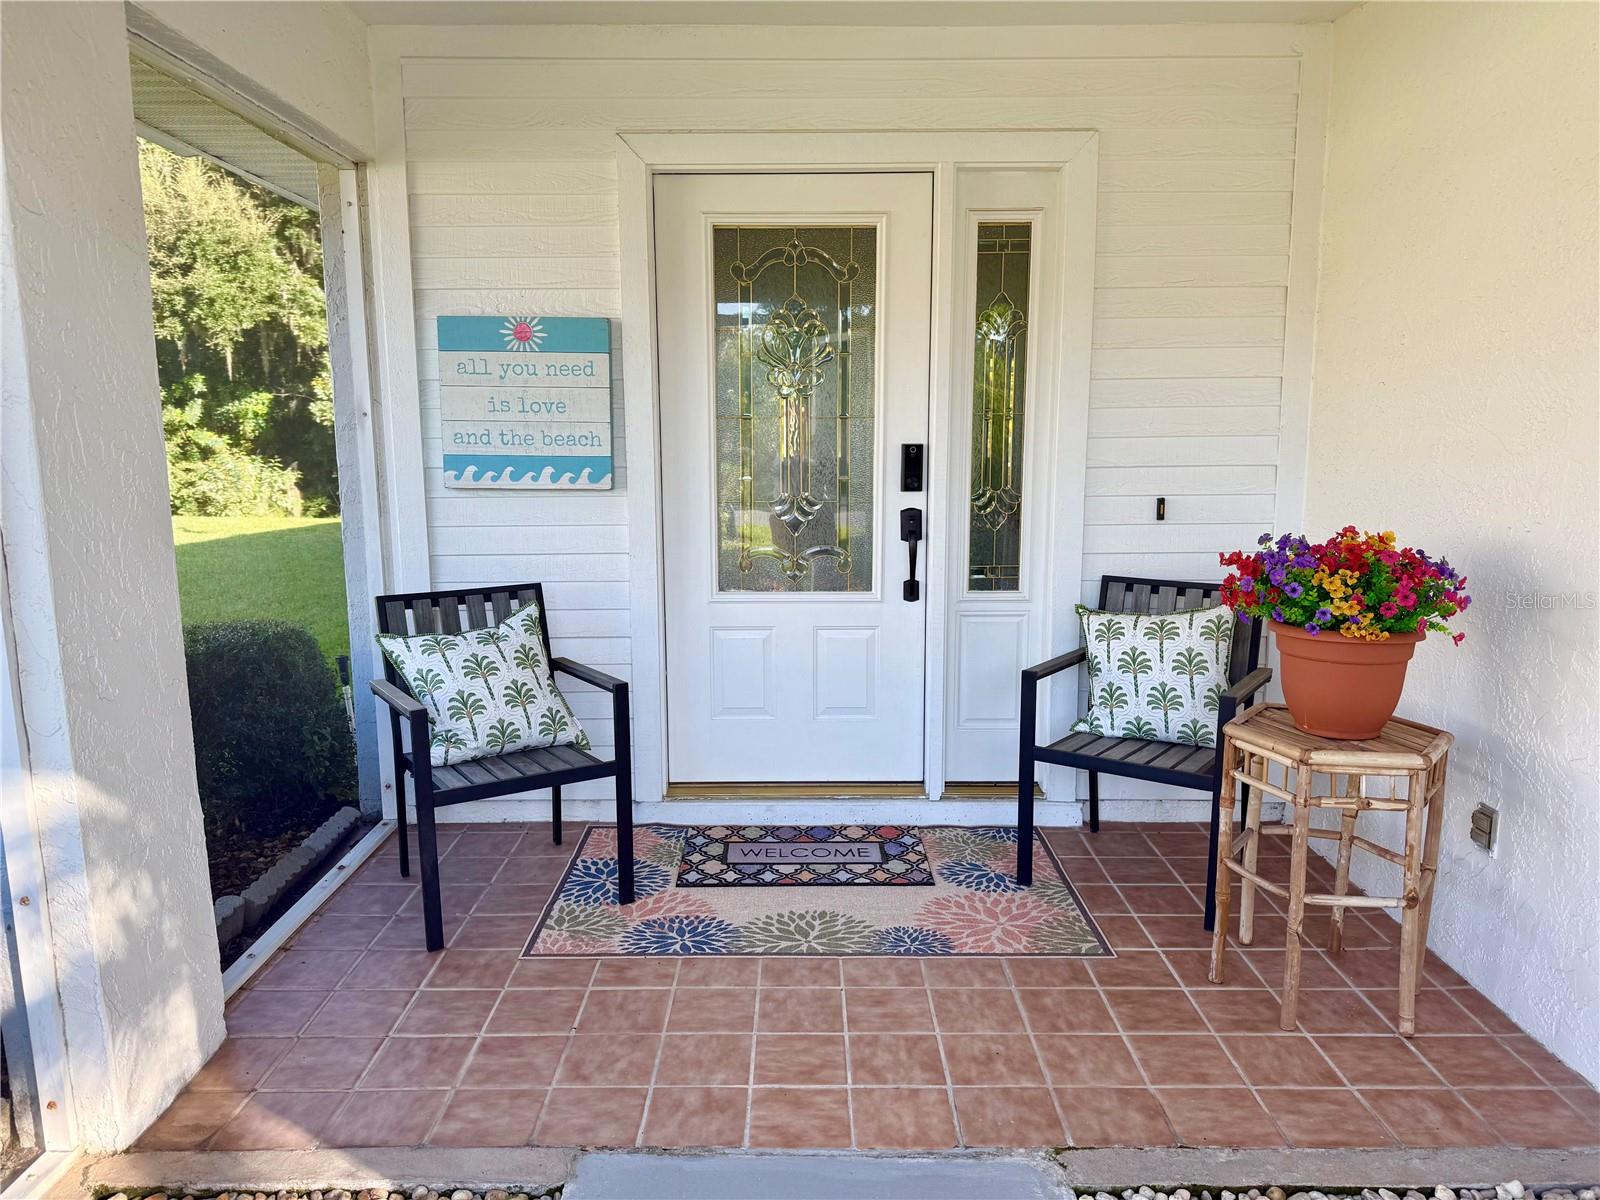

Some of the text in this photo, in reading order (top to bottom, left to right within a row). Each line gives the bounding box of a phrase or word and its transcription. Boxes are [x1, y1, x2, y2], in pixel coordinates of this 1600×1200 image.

[456, 358, 596, 380] all you need
[488, 396, 567, 414] is love
[453, 429, 602, 447] and the beach
[740, 847, 871, 858] WELCOME
